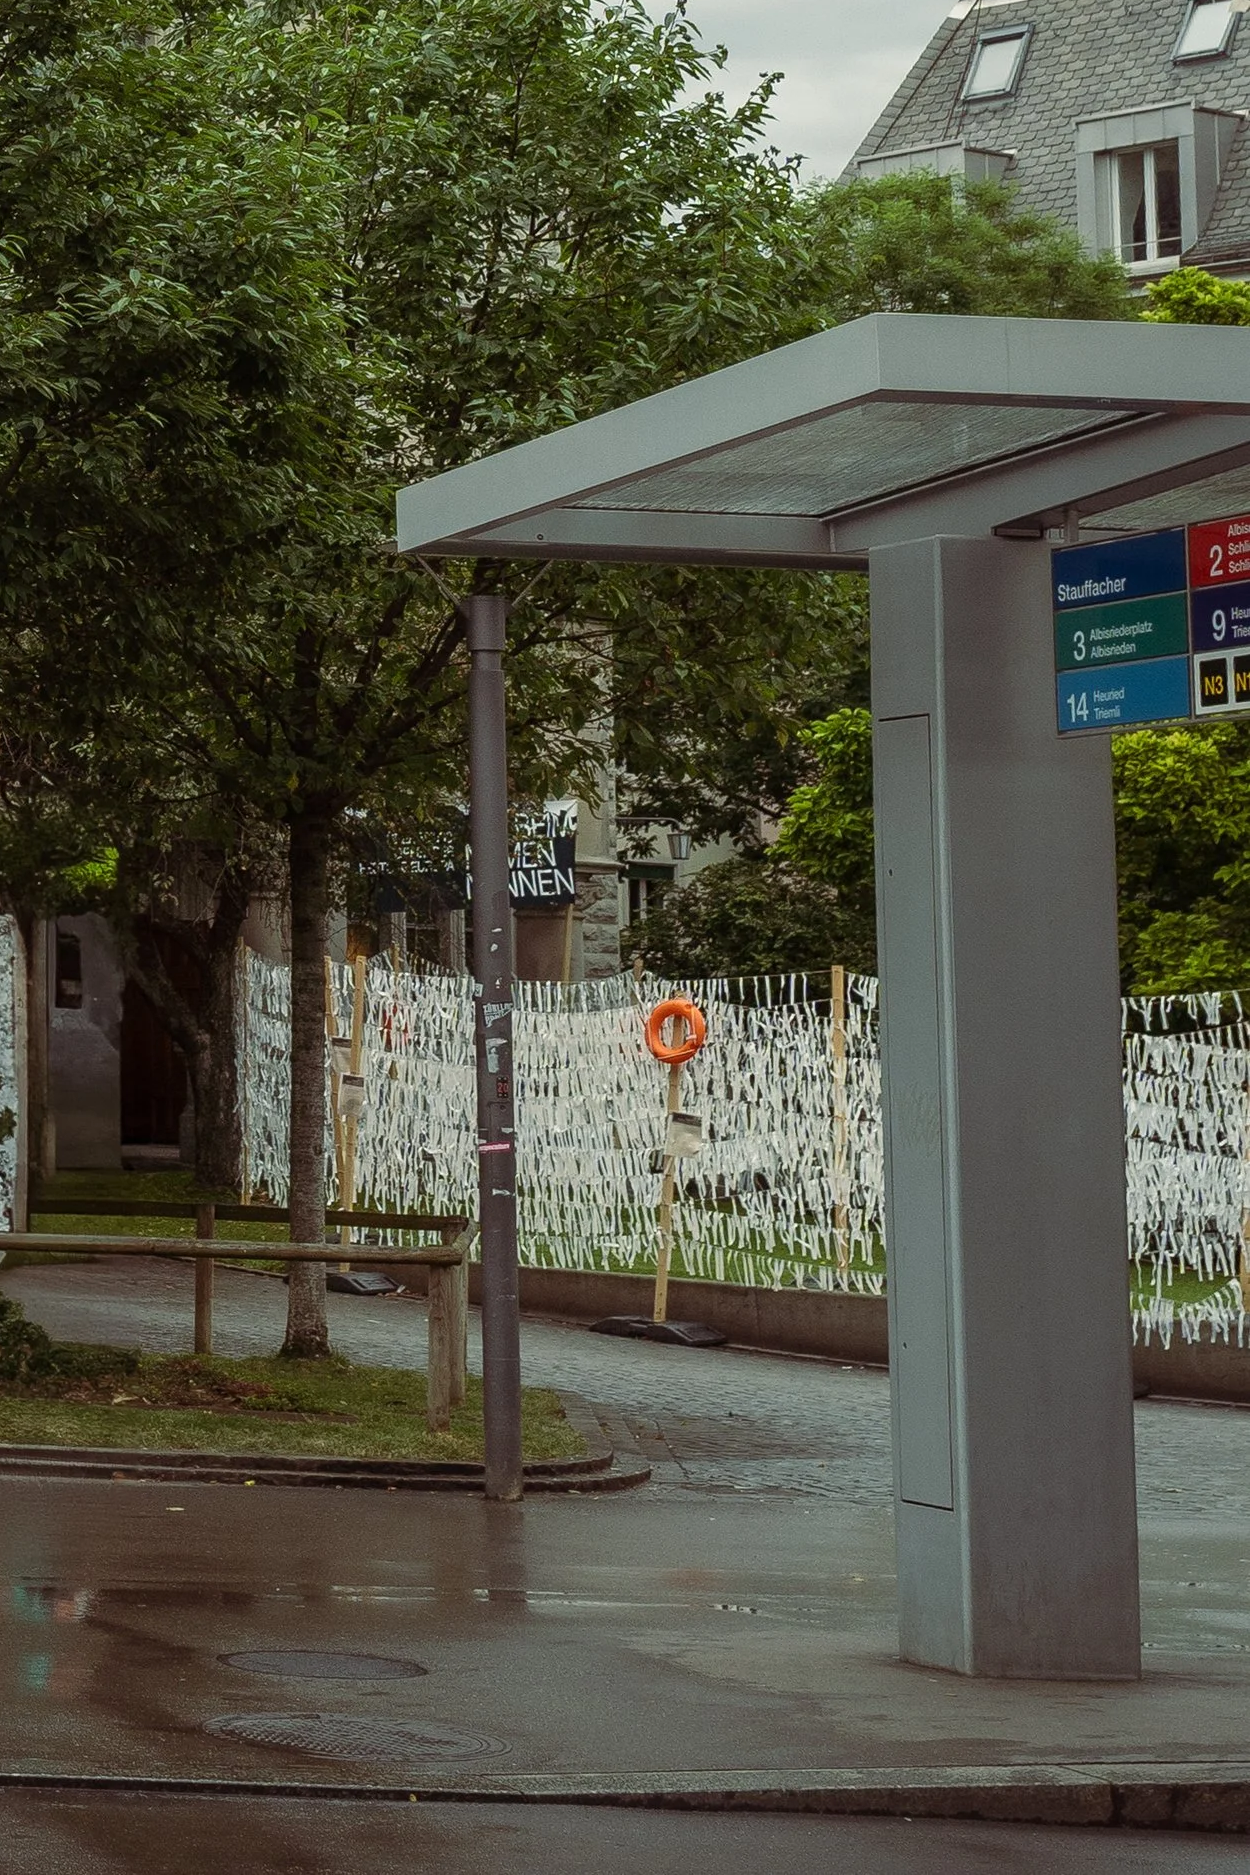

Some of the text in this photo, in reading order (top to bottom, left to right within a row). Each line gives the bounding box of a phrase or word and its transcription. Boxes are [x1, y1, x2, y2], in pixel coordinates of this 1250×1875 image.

[1209, 545, 1223, 576] 2
[1057, 576, 1127, 602] Stauffacher
[1089, 621, 1153, 642] Albisriederplatz
[1212, 609, 1226, 641] 9
[1073, 630, 1086, 661] 3
[1090, 642, 1137, 659] Albisrieden
[1093, 687, 1125, 703] Heuried
[1204, 675, 1224, 696] N3
[1066, 692, 1089, 723] 14
[1093, 705, 1121, 720] Triemli
